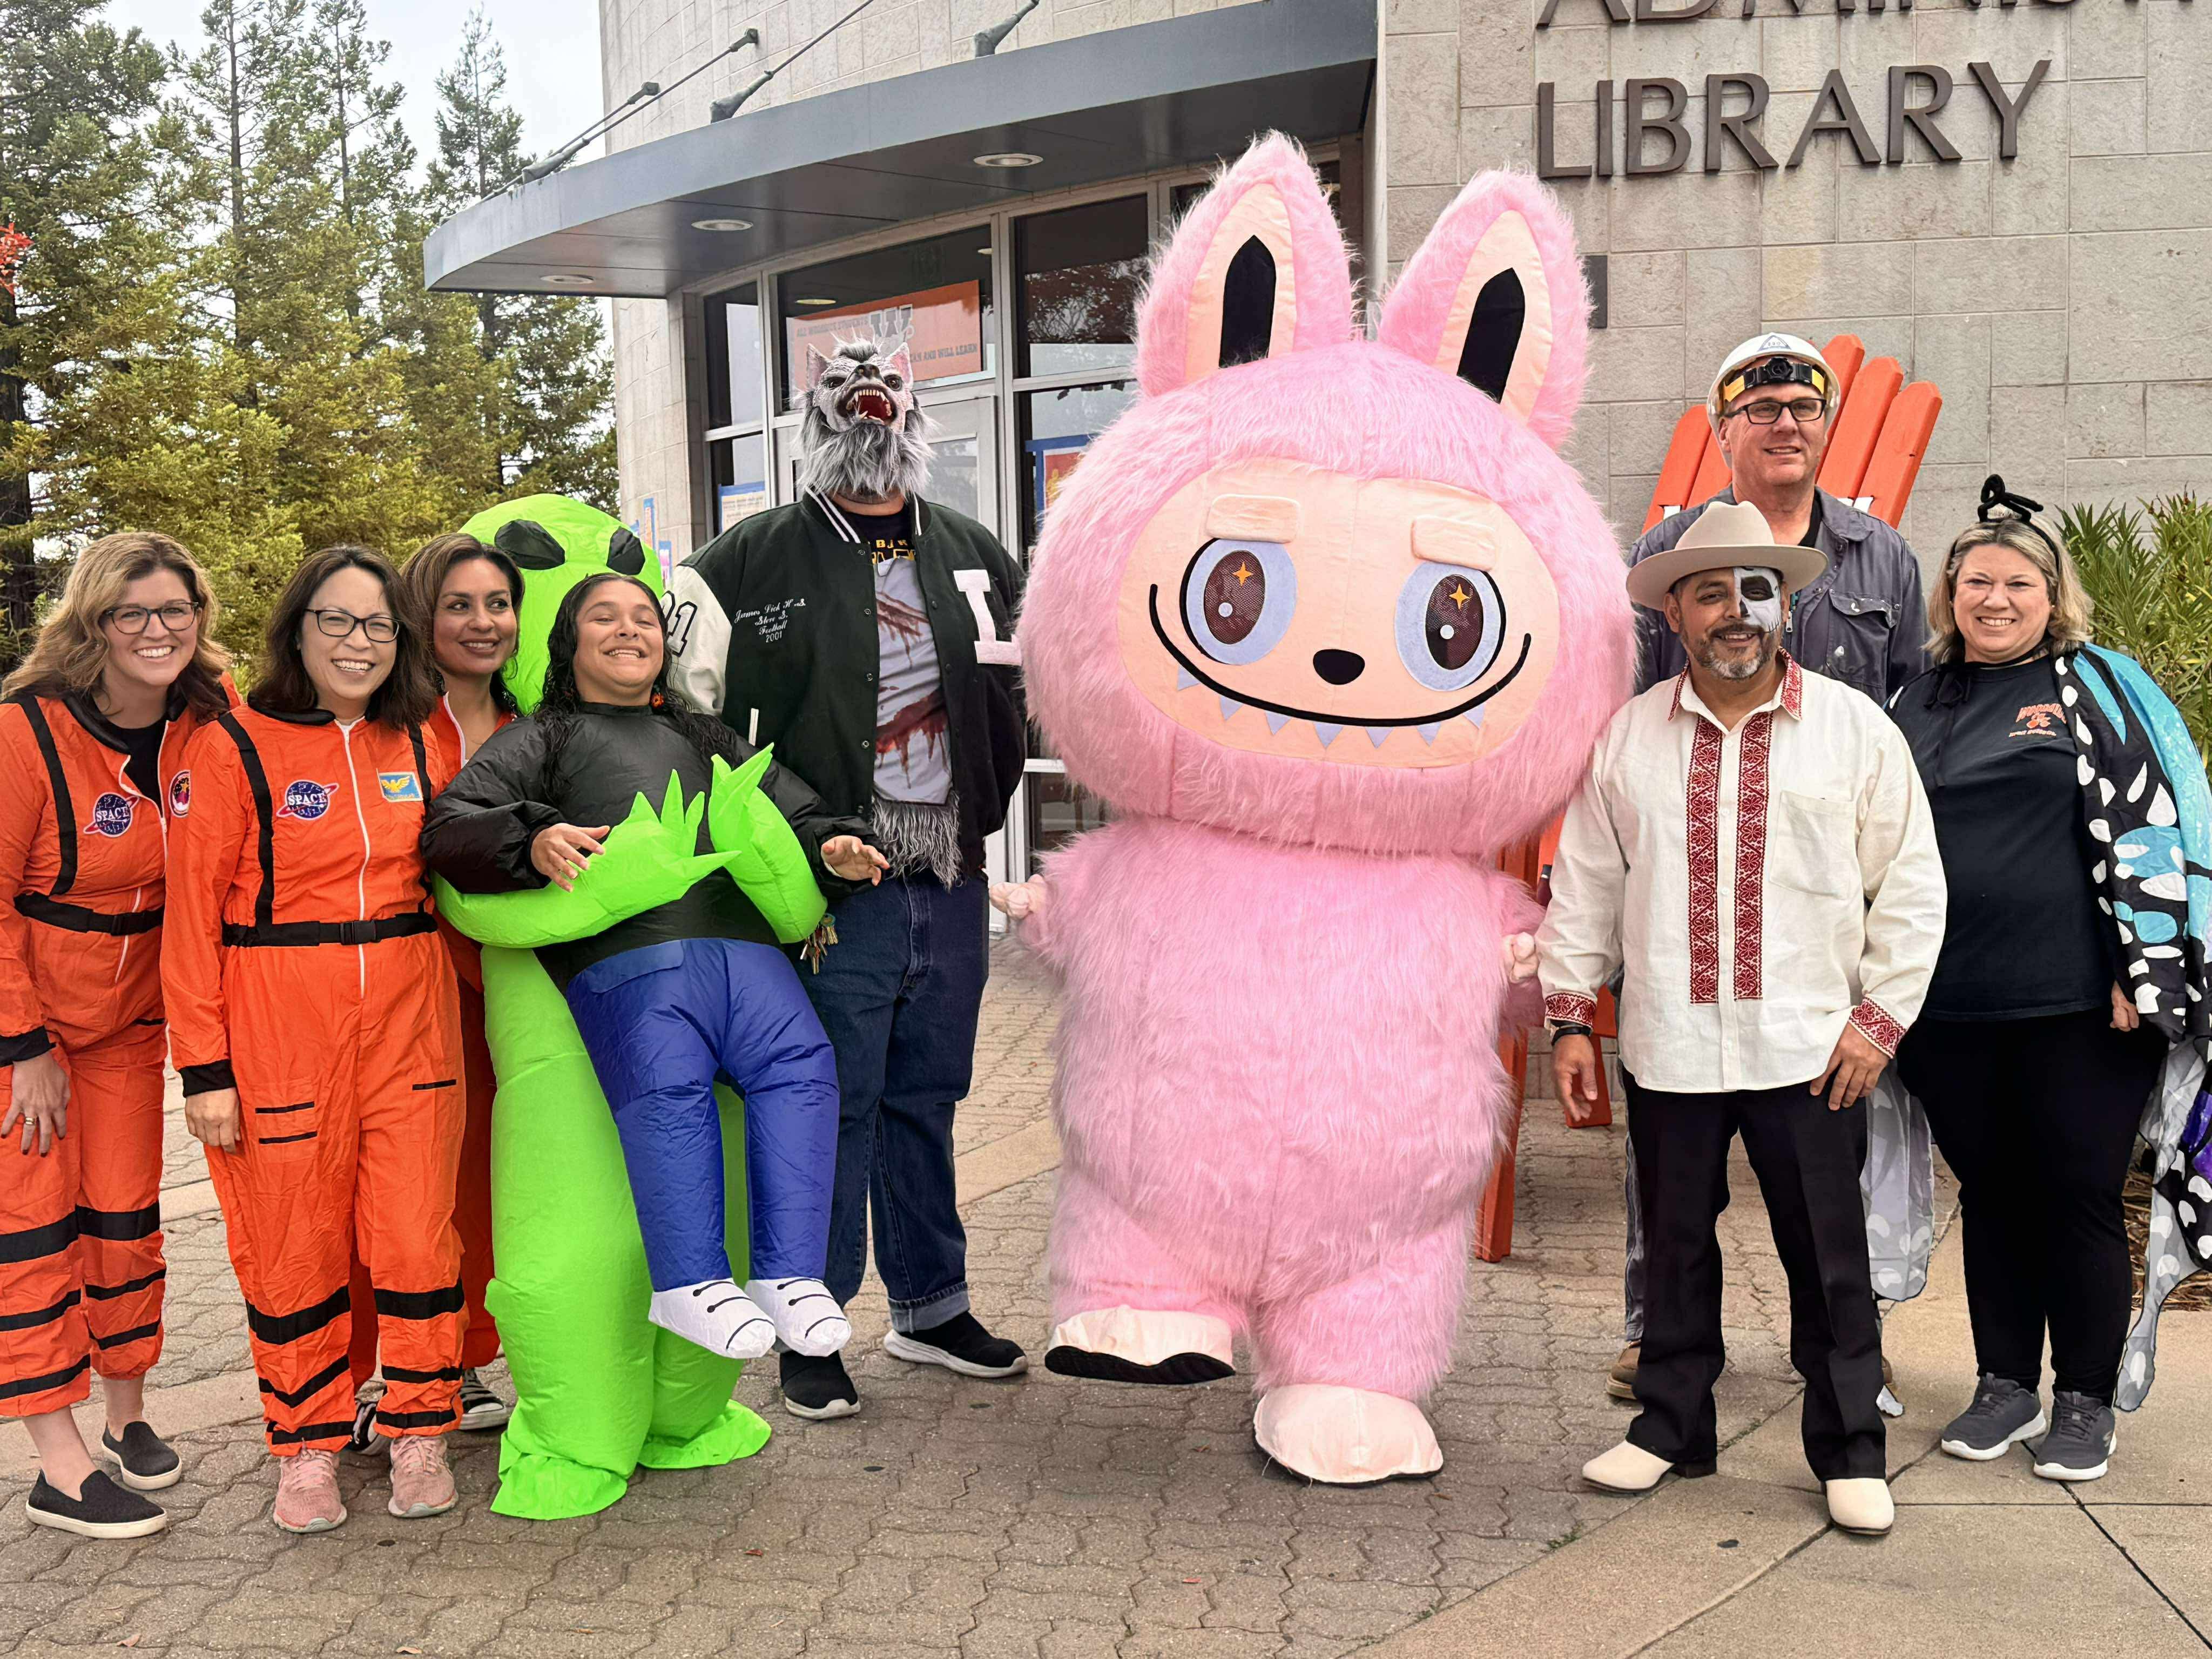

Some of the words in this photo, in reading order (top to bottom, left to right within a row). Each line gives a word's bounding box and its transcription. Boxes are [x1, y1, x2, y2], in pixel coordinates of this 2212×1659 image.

[1538, 59, 2052, 178] LIBRARY
[734, 609, 760, 624] James
[759, 619, 788, 635] Football
[766, 630, 783, 643] 2001
[287, 792, 327, 806] SPACE
[96, 806, 130, 822] SPACE
